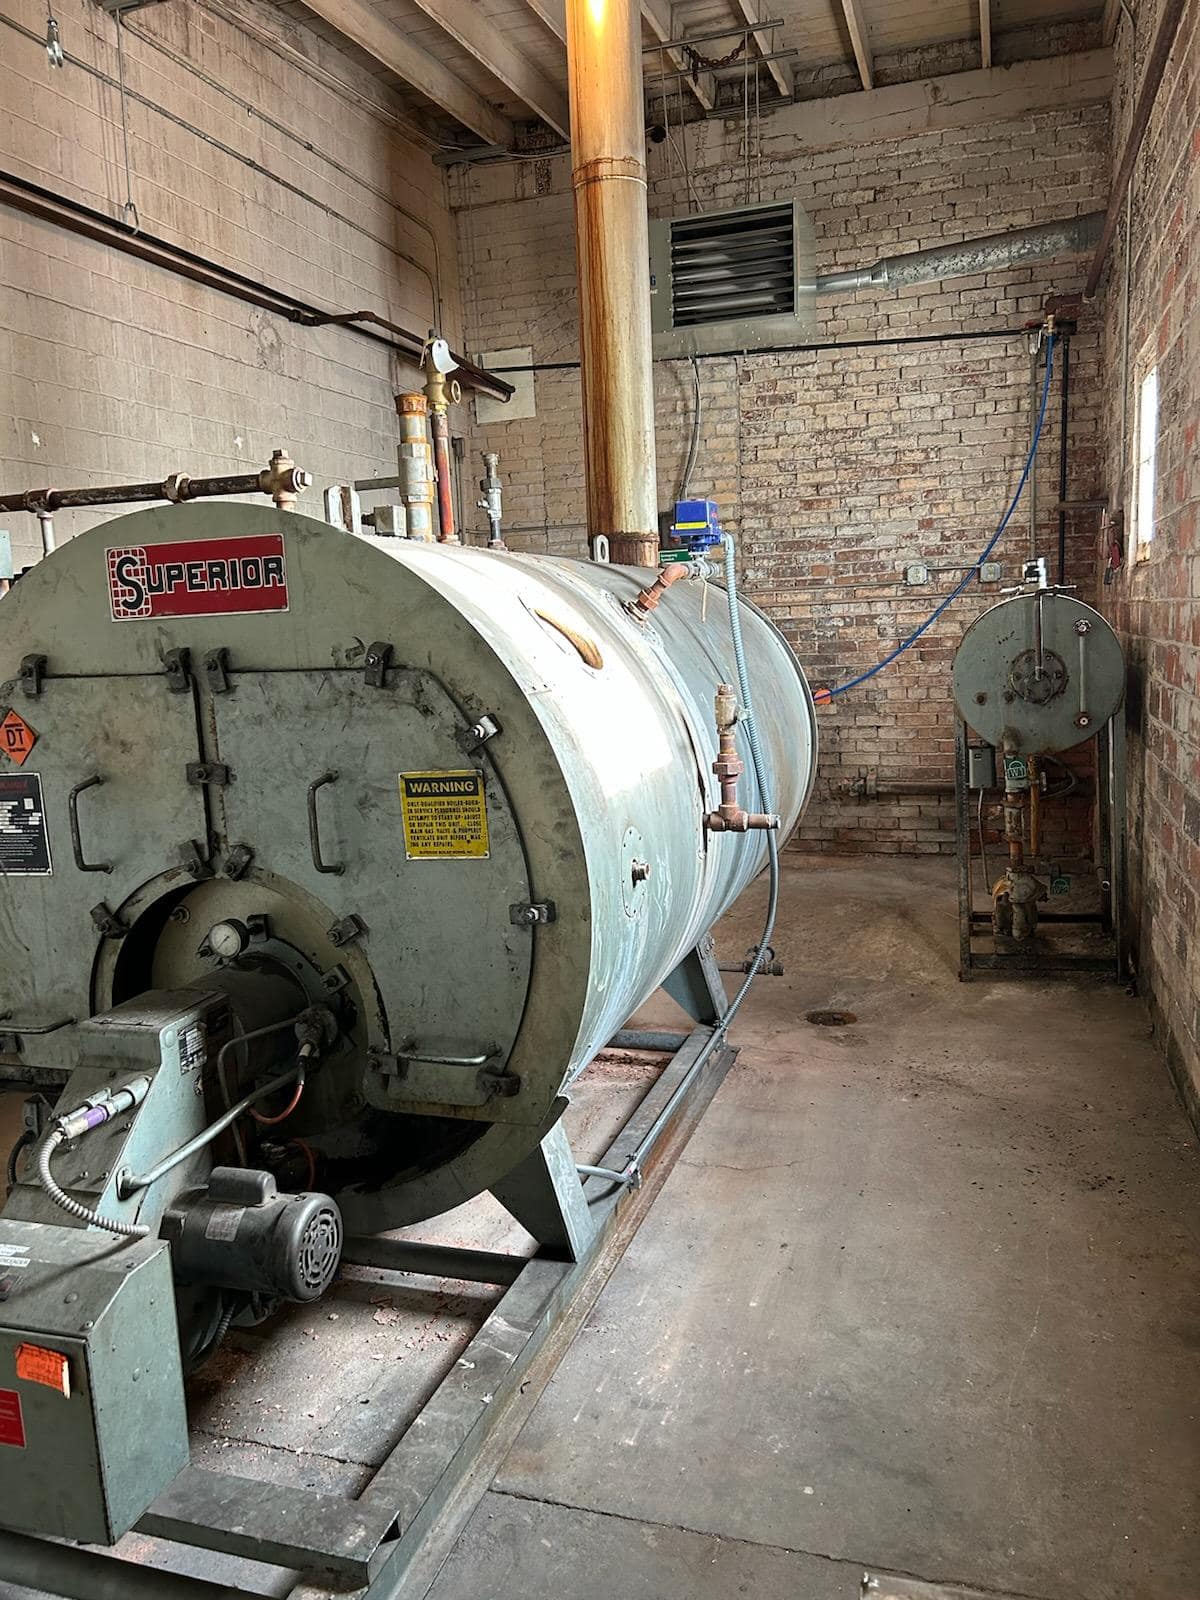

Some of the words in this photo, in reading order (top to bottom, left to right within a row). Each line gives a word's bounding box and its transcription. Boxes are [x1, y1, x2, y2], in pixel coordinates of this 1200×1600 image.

[115, 554, 286, 611] SUPERIOR
[6, 728, 25, 747] DT
[409, 781, 475, 793] WARNING
